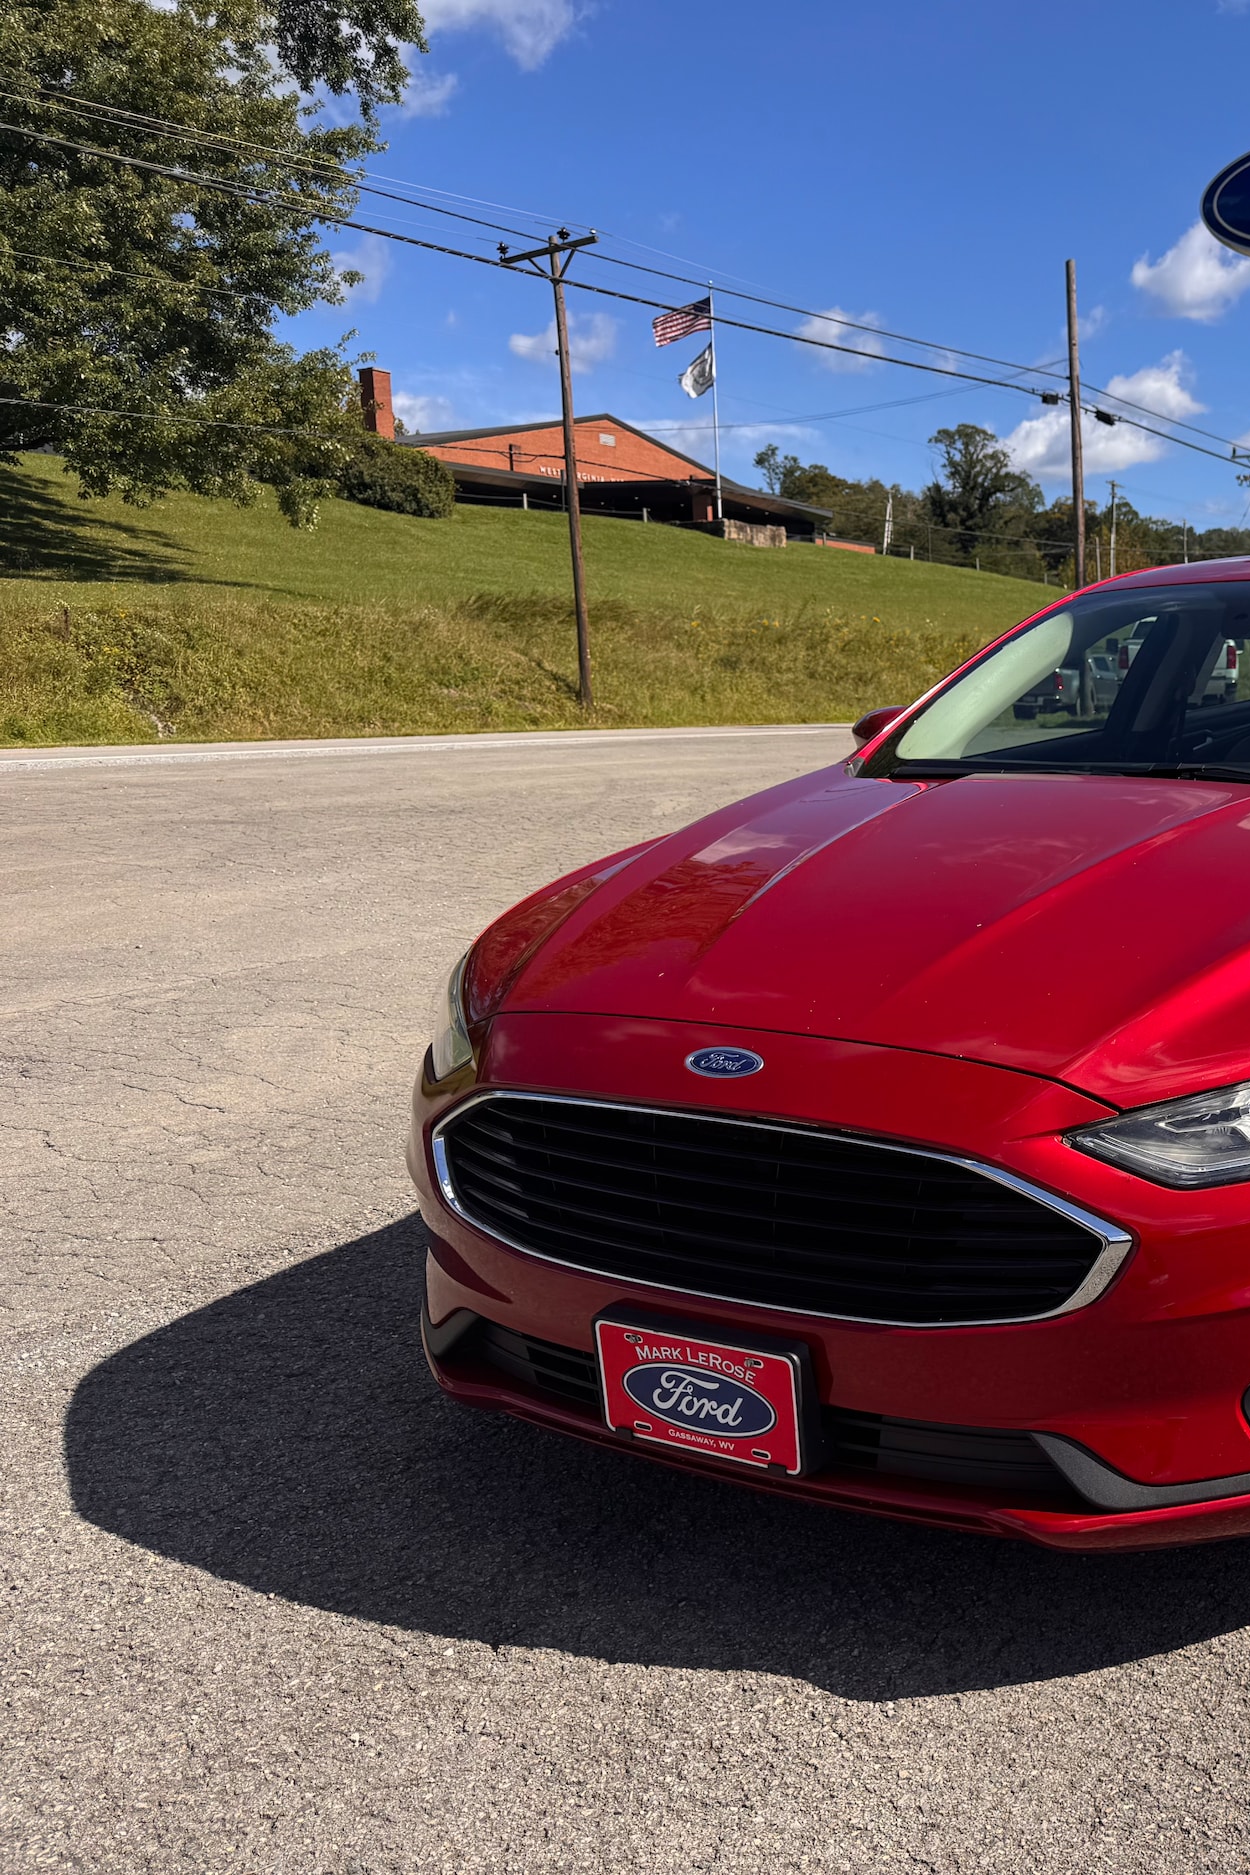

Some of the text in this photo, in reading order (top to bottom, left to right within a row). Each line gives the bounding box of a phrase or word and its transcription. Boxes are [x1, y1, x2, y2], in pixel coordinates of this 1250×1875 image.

[540, 466, 561, 476] WEST
[700, 1051, 747, 1071] Ford
[652, 1370, 743, 1427] Ford
[718, 1440, 735, 1451] WV
